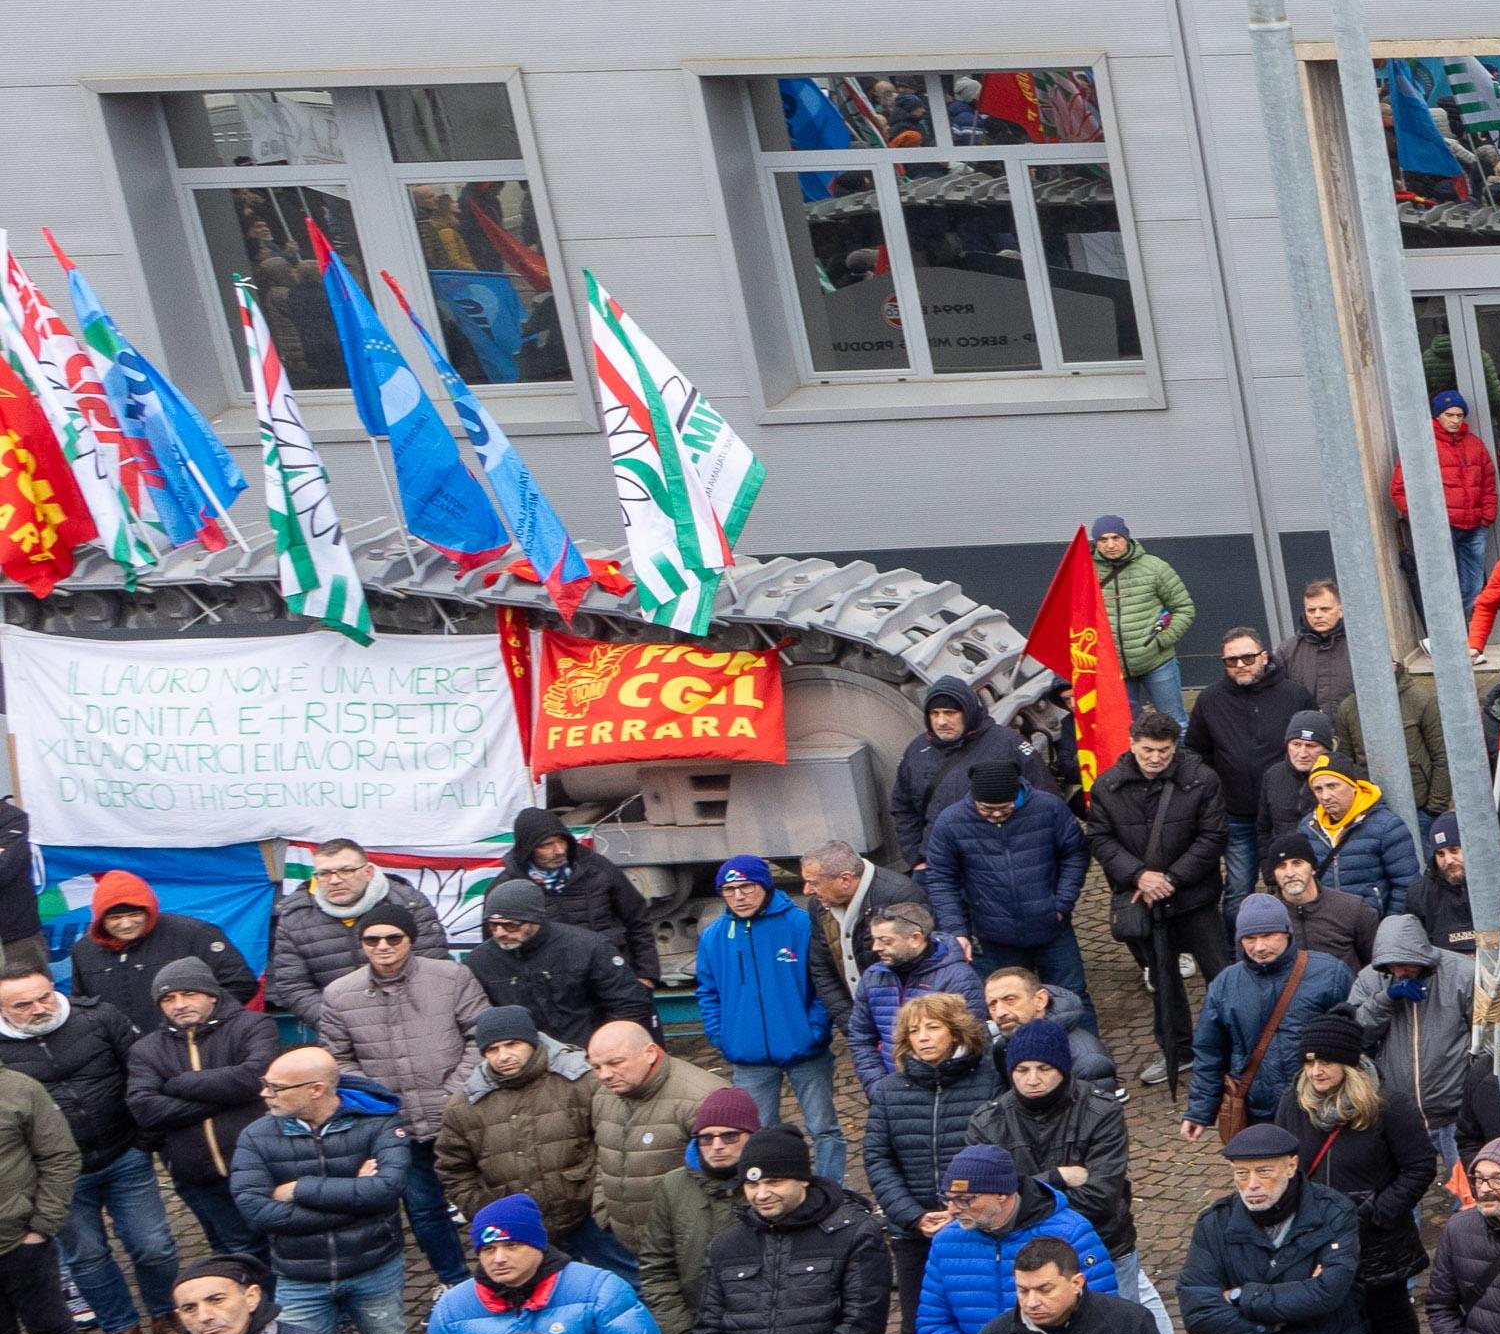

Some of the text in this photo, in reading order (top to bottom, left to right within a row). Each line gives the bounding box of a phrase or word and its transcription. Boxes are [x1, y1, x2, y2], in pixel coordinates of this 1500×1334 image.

[101, 666, 212, 697] LAVORO
[221, 665, 280, 694] NON
[321, 665, 375, 695] UNA
[388, 665, 499, 696] MERCE
[547, 715, 757, 751] FERRARA
[95, 778, 176, 811] BERCO
[176, 781, 396, 811] THYSSENKRUPP
[413, 780, 499, 812] ITALIA
